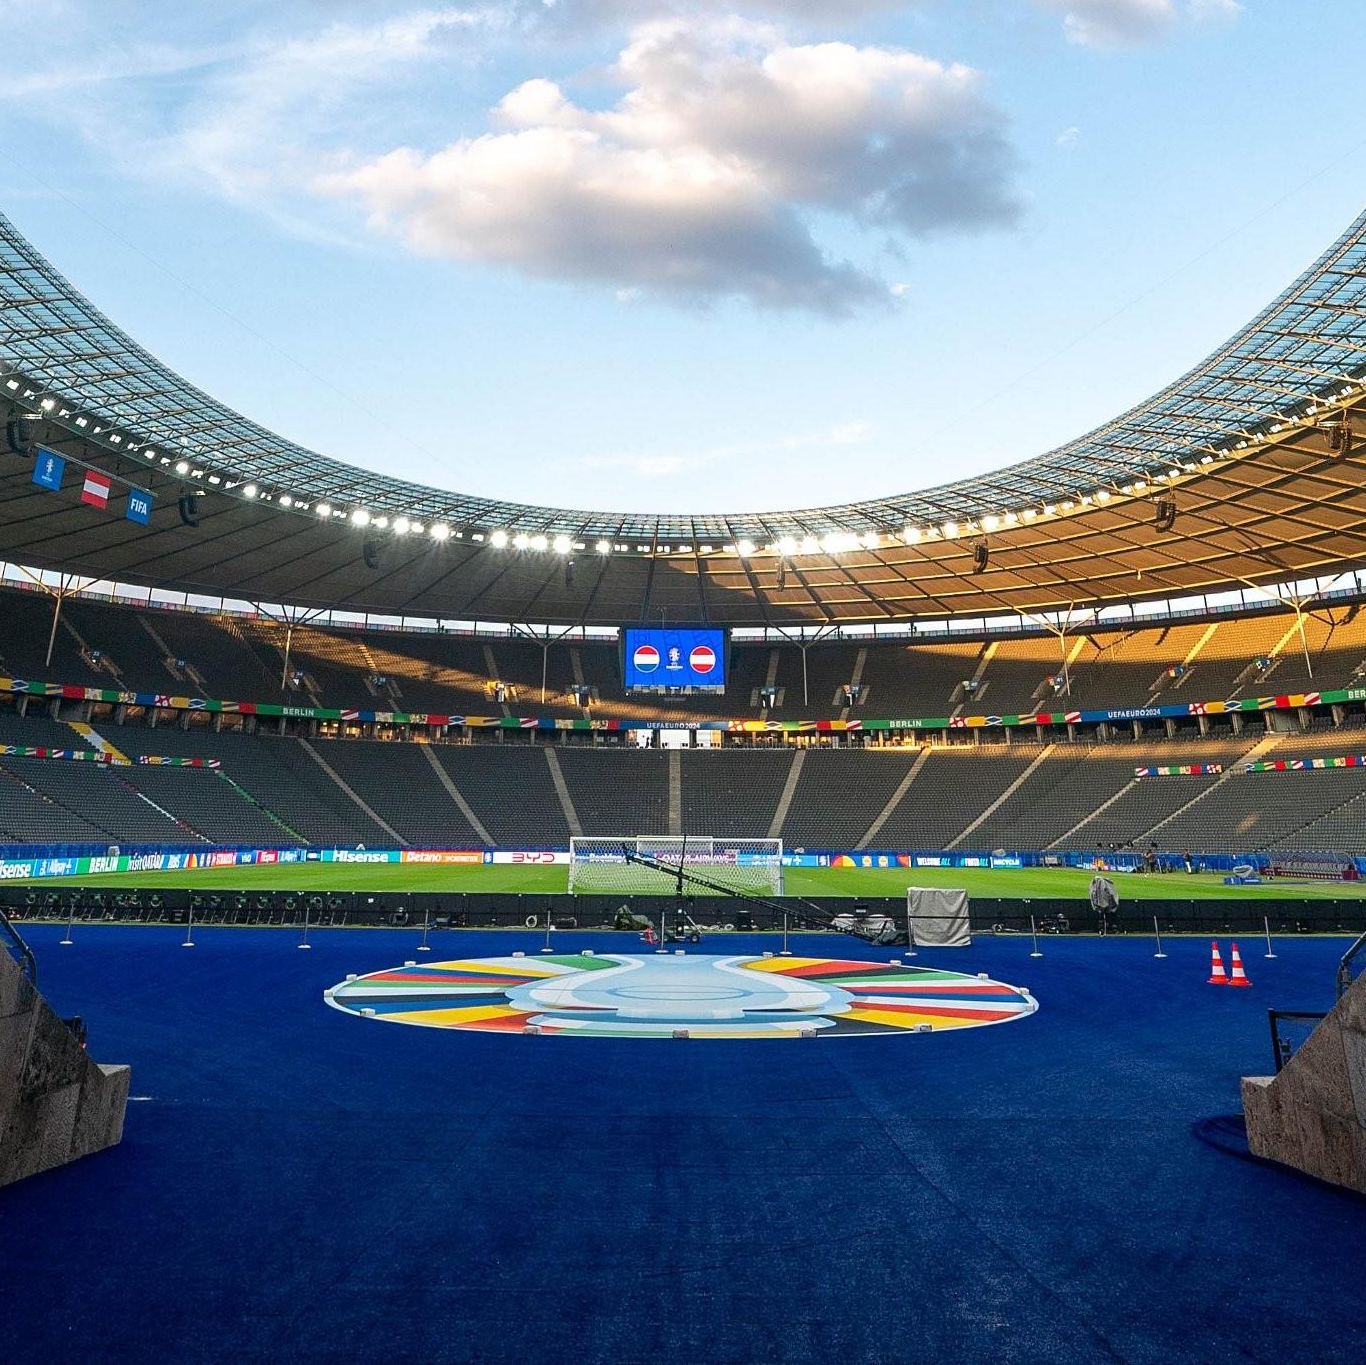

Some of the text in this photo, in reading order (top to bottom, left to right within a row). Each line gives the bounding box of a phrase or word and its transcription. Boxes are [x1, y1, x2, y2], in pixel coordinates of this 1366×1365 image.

[130, 498, 147, 515] FIFA
[283, 707, 315, 717] BERLIN
[889, 720, 922, 728] BERLIN
[332, 850, 388, 862] Hisense
[512, 852, 555, 863] BYD
[89, 856, 118, 873] BERLIN
